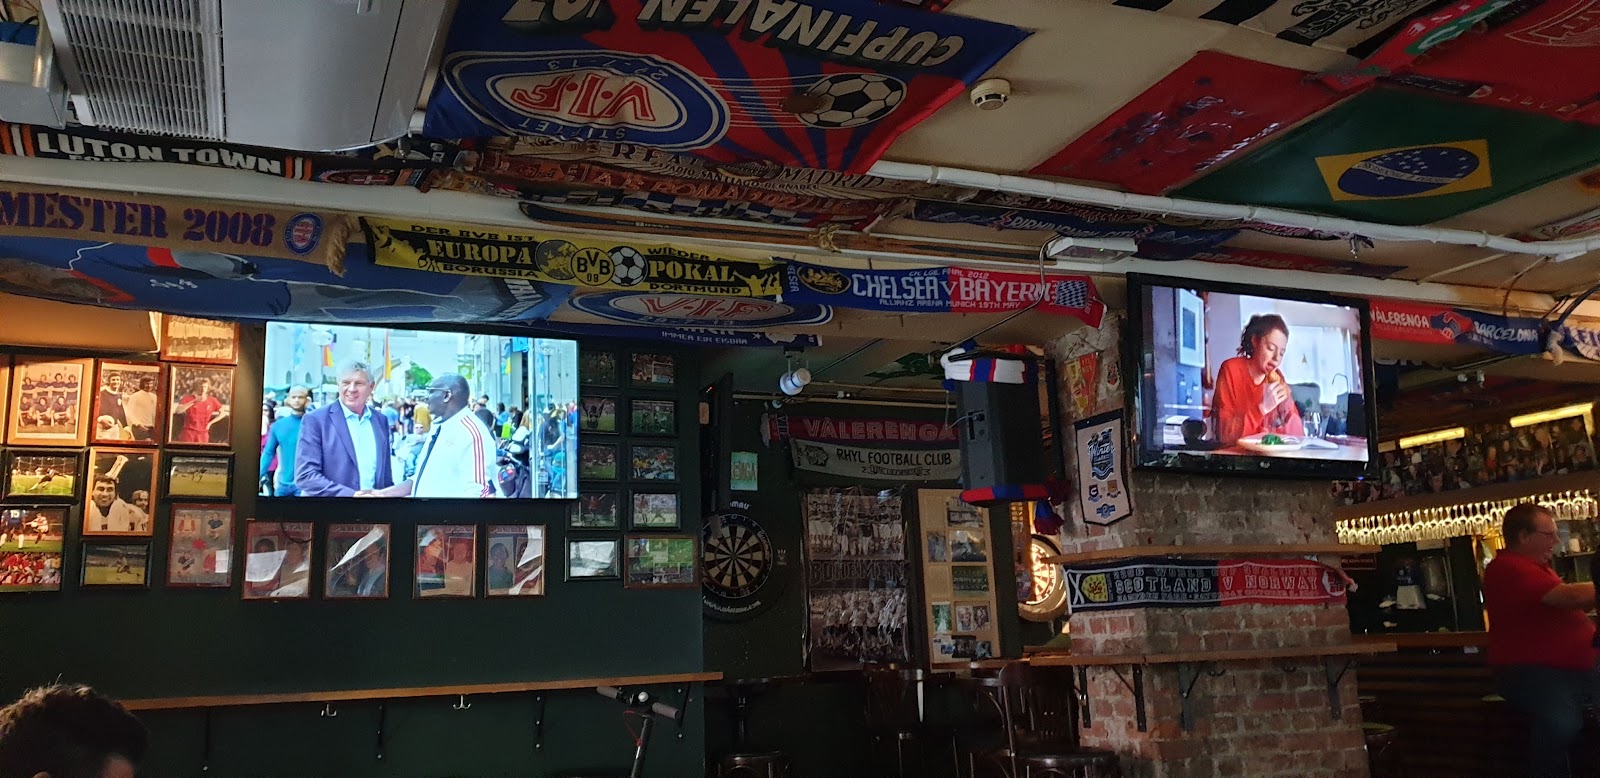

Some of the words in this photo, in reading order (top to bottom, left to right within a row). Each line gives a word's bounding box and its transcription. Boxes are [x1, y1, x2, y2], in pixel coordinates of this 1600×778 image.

[37, 132, 164, 162] LUTON
[171, 147, 282, 175] TOWN
[779, 165, 886, 189] MADRID
[182, 207, 277, 248] 2008
[410, 224, 452, 236] DER
[458, 229, 500, 240] BVB
[426, 238, 533, 266] EUROPA
[576, 250, 611, 276] BVB
[646, 246, 710, 262] WIEDER
[442, 262, 540, 279] BORUSSIA
[648, 259, 736, 283] POKAL
[967, 270, 990, 280] 2012
[649, 282, 742, 295] DORTMUND
[851, 272, 940, 301] CHELSEA
[959, 276, 1052, 303] BAYERN
[916, 299, 944, 308] ARENA
[945, 300, 977, 309] MUNICH
[977, 301, 1001, 309] 19TH
[1001, 301, 1022, 310] MAY
[1472, 319, 1539, 342] BARCELONA
[803, 416, 957, 441] VÅLERENGA
[836, 447, 865, 463] RHYL
[867, 450, 922, 466] FOOTBALL
[924, 452, 952, 466] CLUB
[1154, 567, 1206, 579] WORLD
[1114, 576, 1212, 595] SCOTLAND
[1245, 574, 1319, 591] NORWAY
